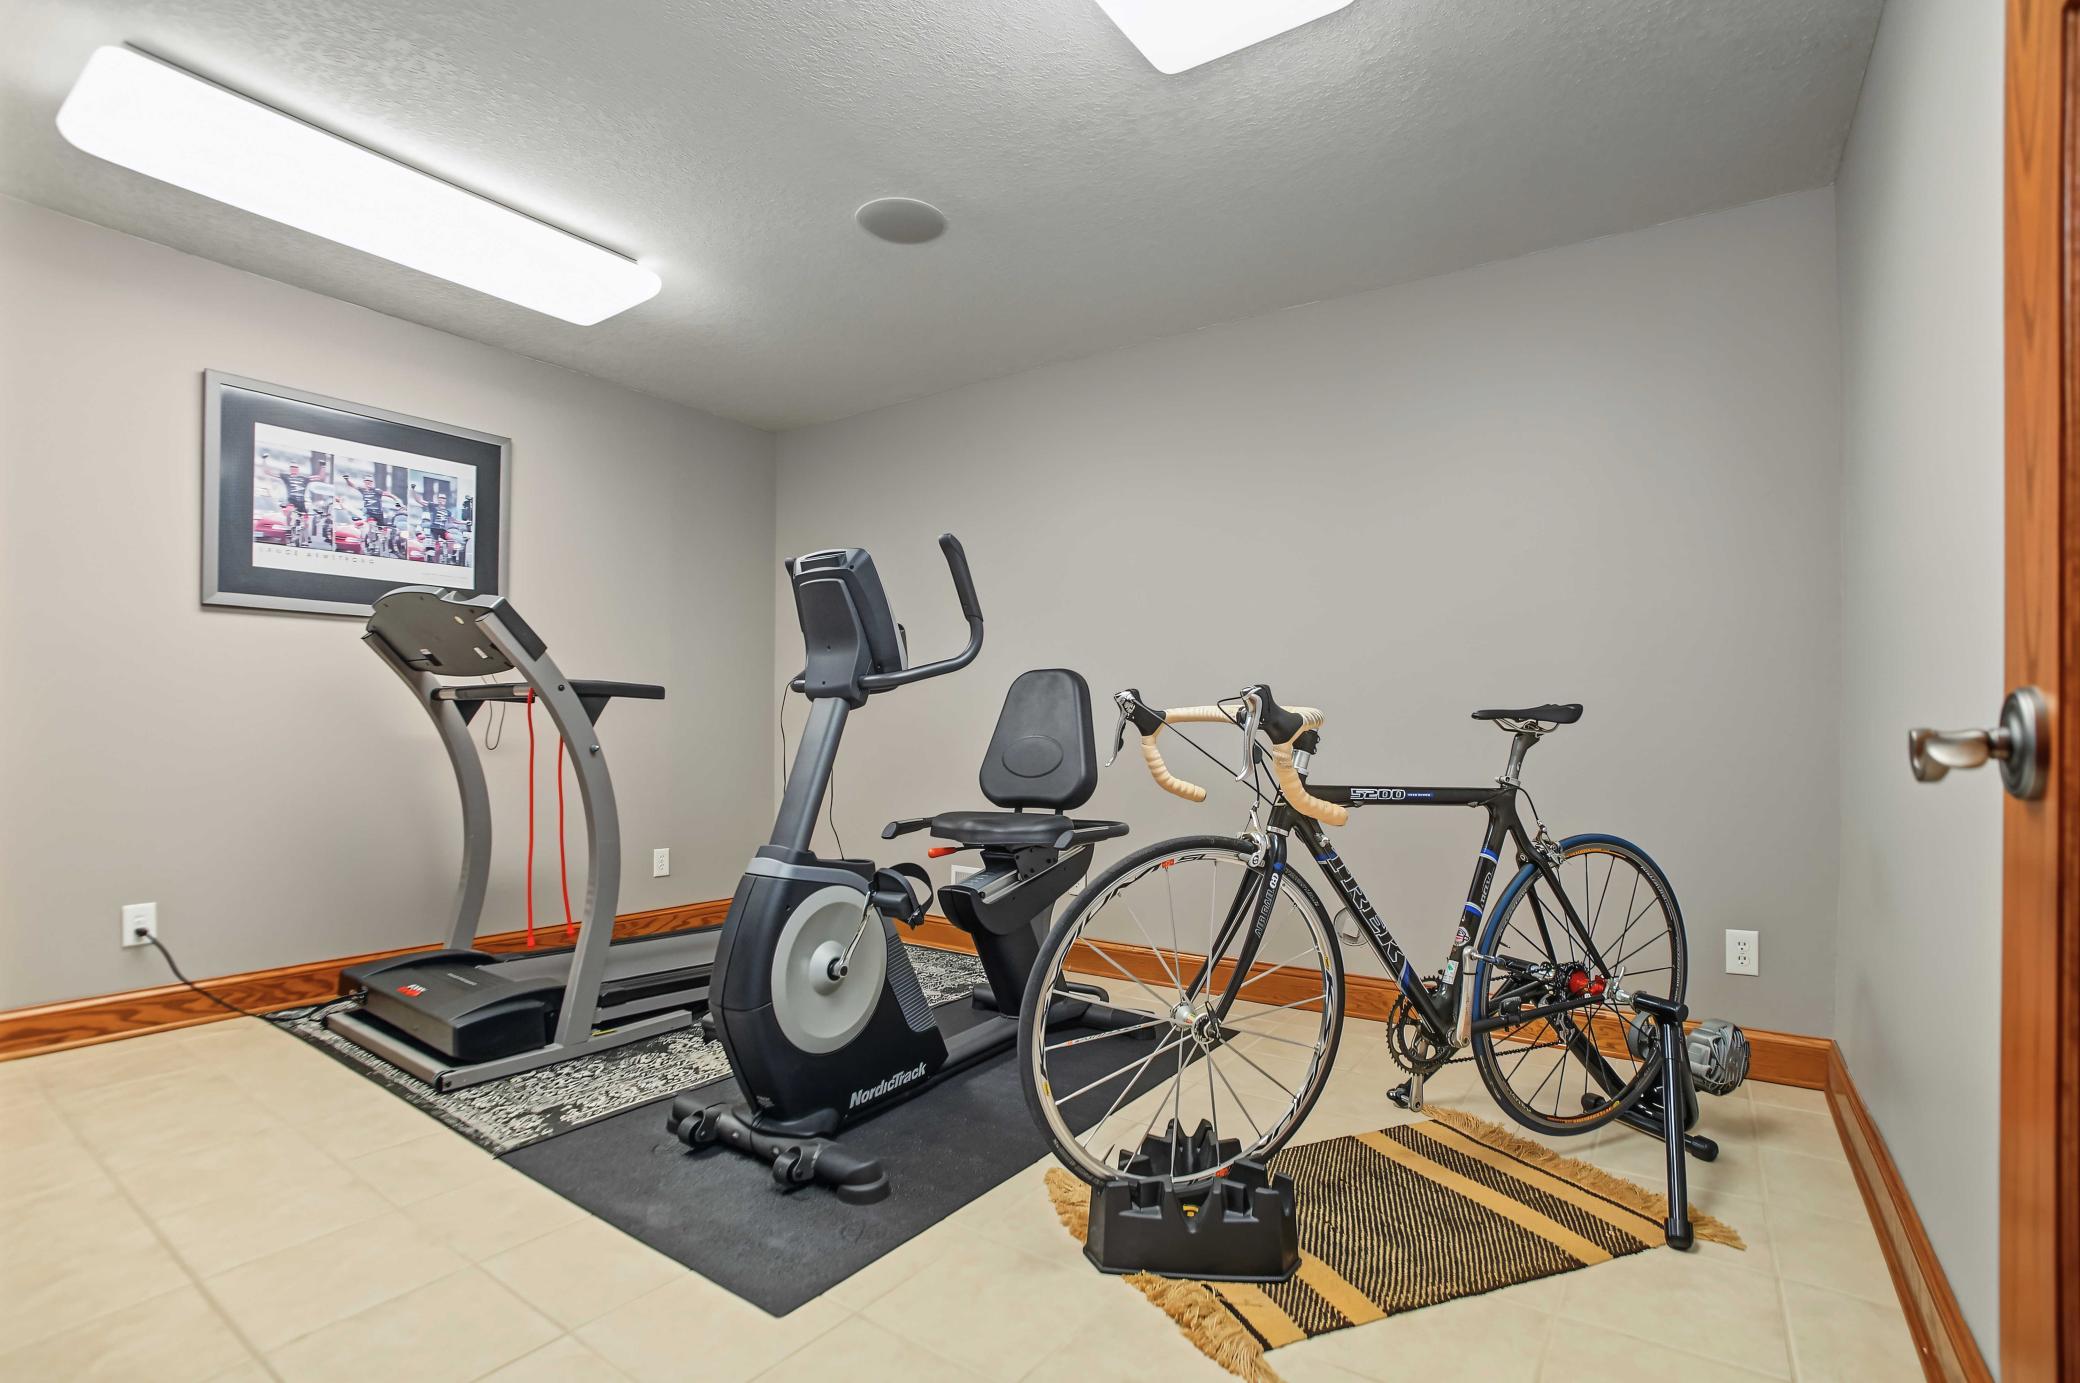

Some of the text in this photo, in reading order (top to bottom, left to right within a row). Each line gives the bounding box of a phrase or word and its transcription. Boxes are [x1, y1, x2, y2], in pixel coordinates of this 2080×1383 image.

[1350, 788, 1406, 800] 5200
[1327, 855, 1406, 963] TREK
[849, 1062, 927, 1109] NordicTrack
